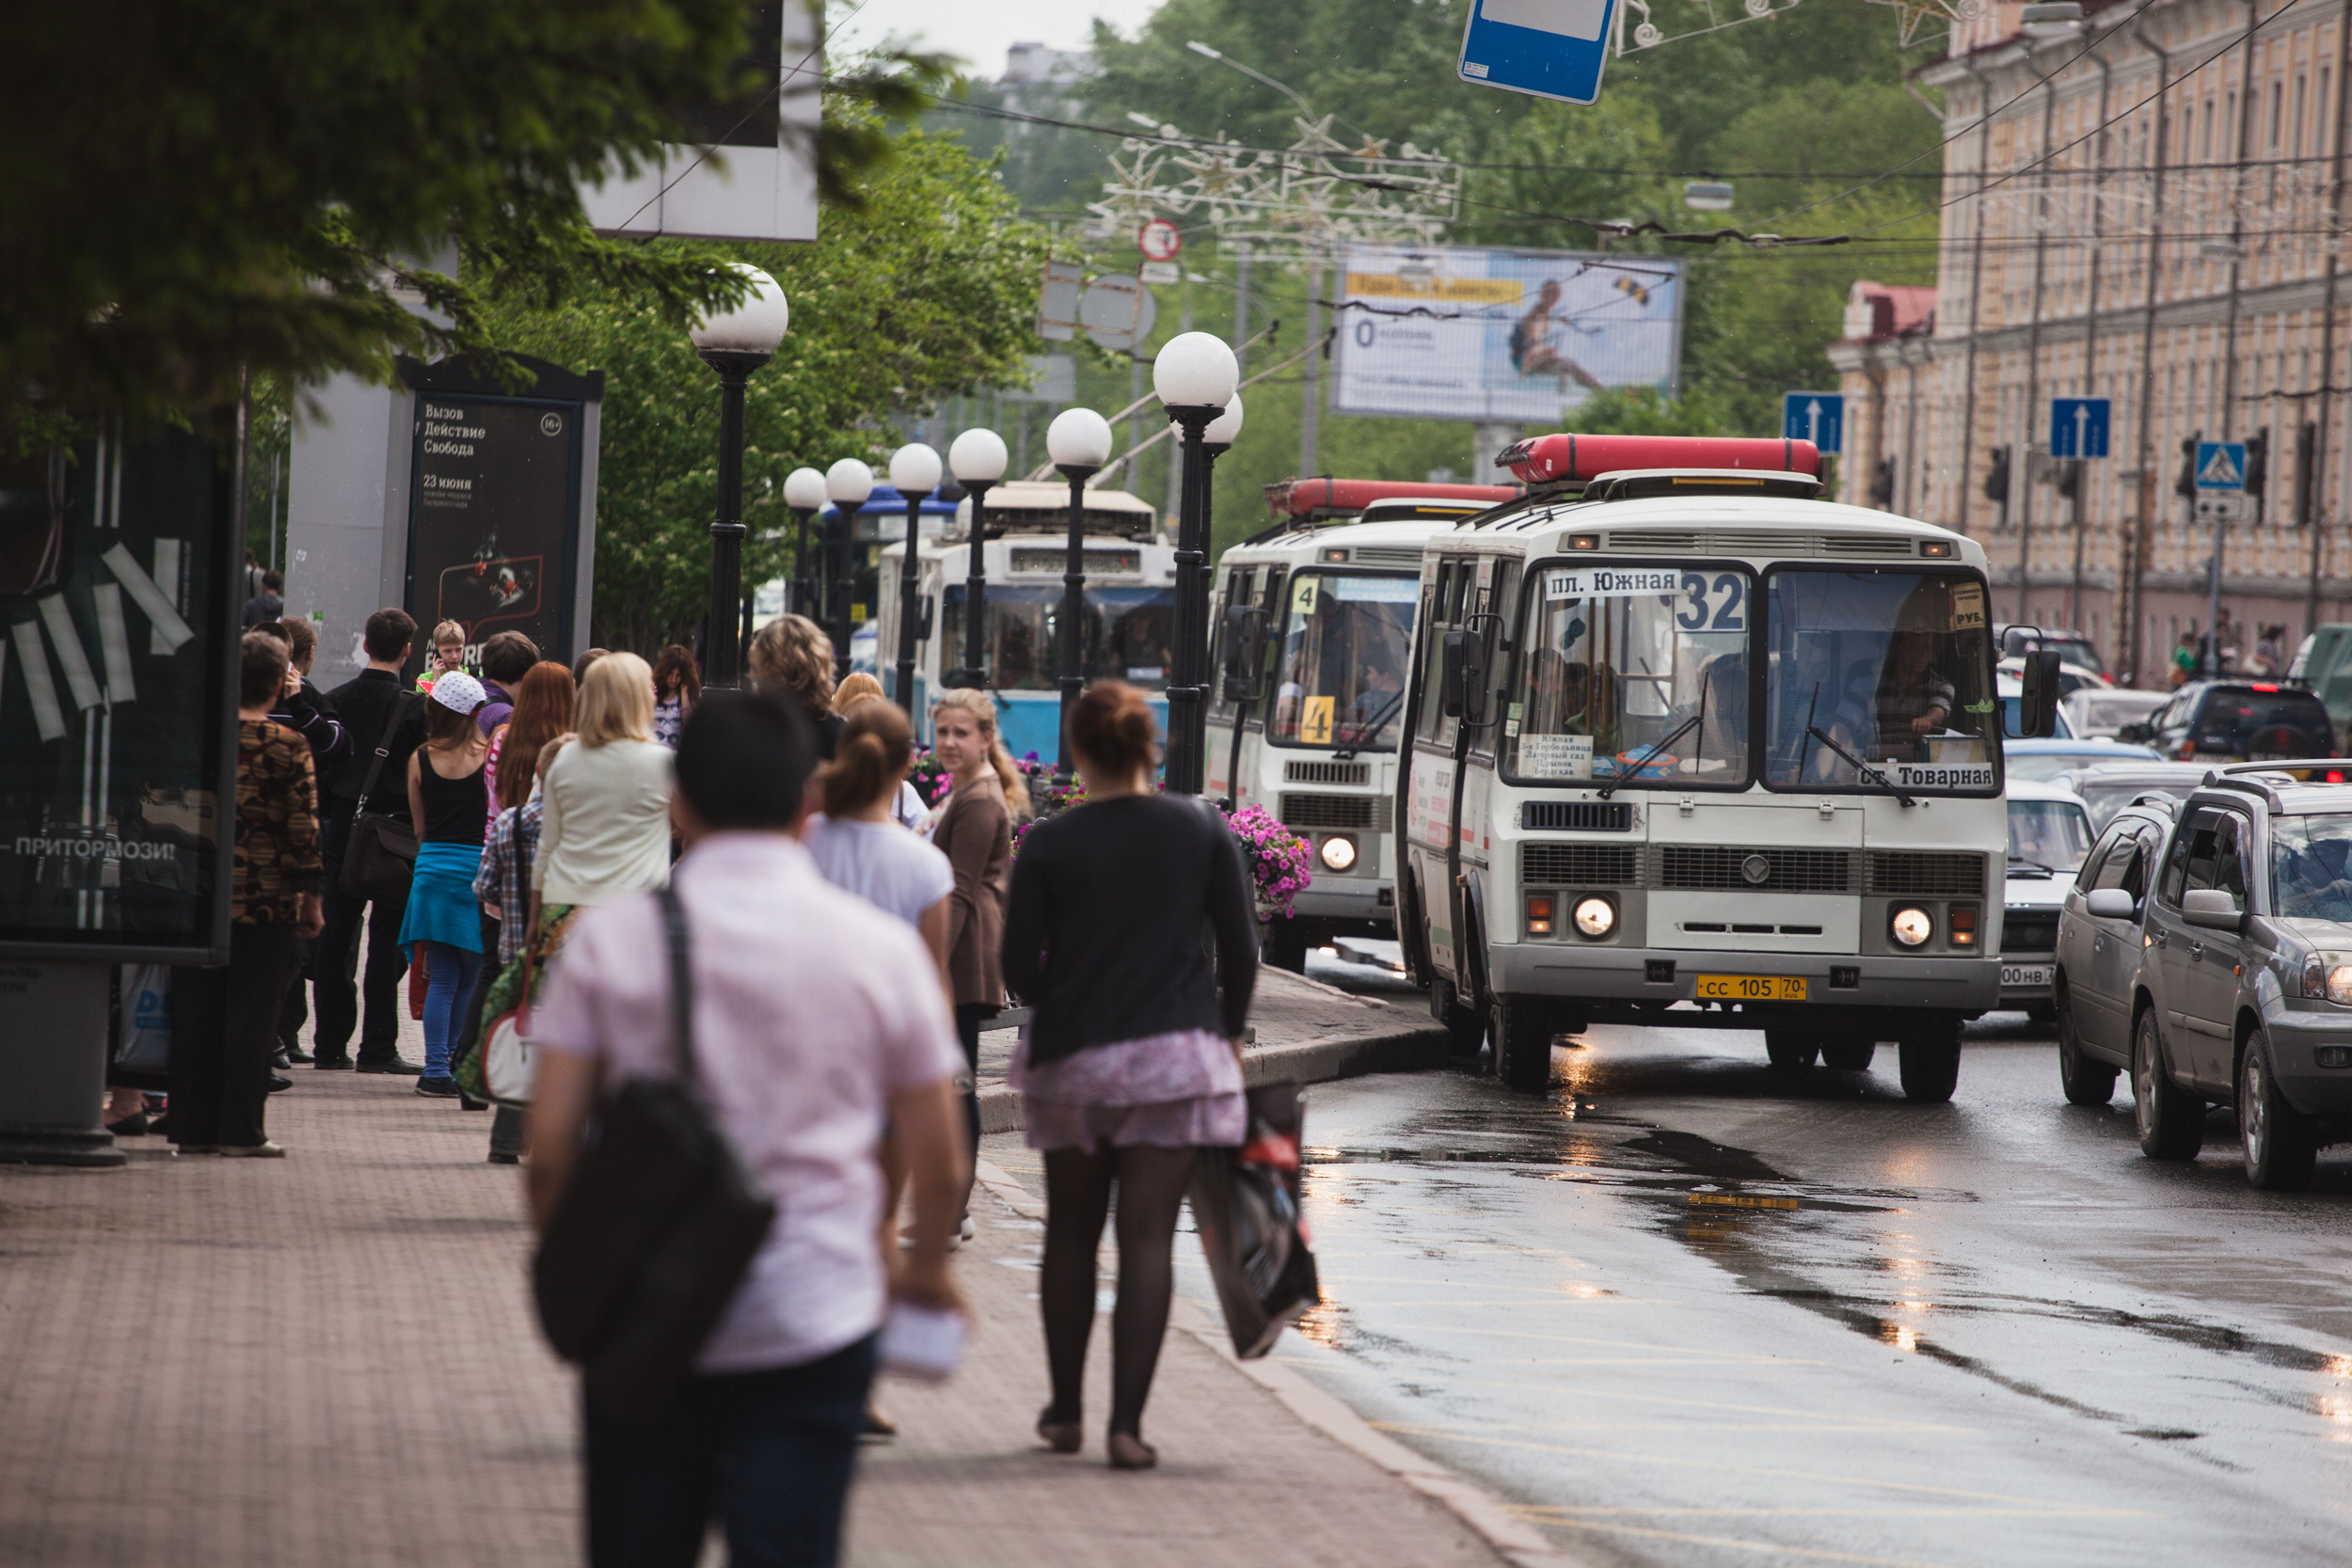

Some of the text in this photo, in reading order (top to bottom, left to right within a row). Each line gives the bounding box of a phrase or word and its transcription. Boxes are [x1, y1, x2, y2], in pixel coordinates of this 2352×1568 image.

[425, 404, 464, 420] Вызов
[424, 421, 486, 439] Действие
[544, 418, 560, 432] 16+
[423, 438, 474, 457] Свобода
[423, 473, 472, 491] 23 июня
[1551, 572, 1676, 594] пл. Южная
[1299, 586, 1313, 608] 4
[1676, 573, 1743, 630] 32
[1956, 611, 1984, 625] РУБ.
[1304, 702, 1329, 740] 4
[1535, 742, 1592, 752] Горбольница
[1542, 735, 1574, 743] Южная
[1525, 751, 1585, 761] Лагерный сад
[1534, 768, 1574, 778] Бердская
[1899, 767, 1993, 788] Товарная
[16, 836, 177, 861] ПРИТОРМОЗИ!
[1739, 979, 1772, 997] 105
[1783, 979, 1801, 992] 70
